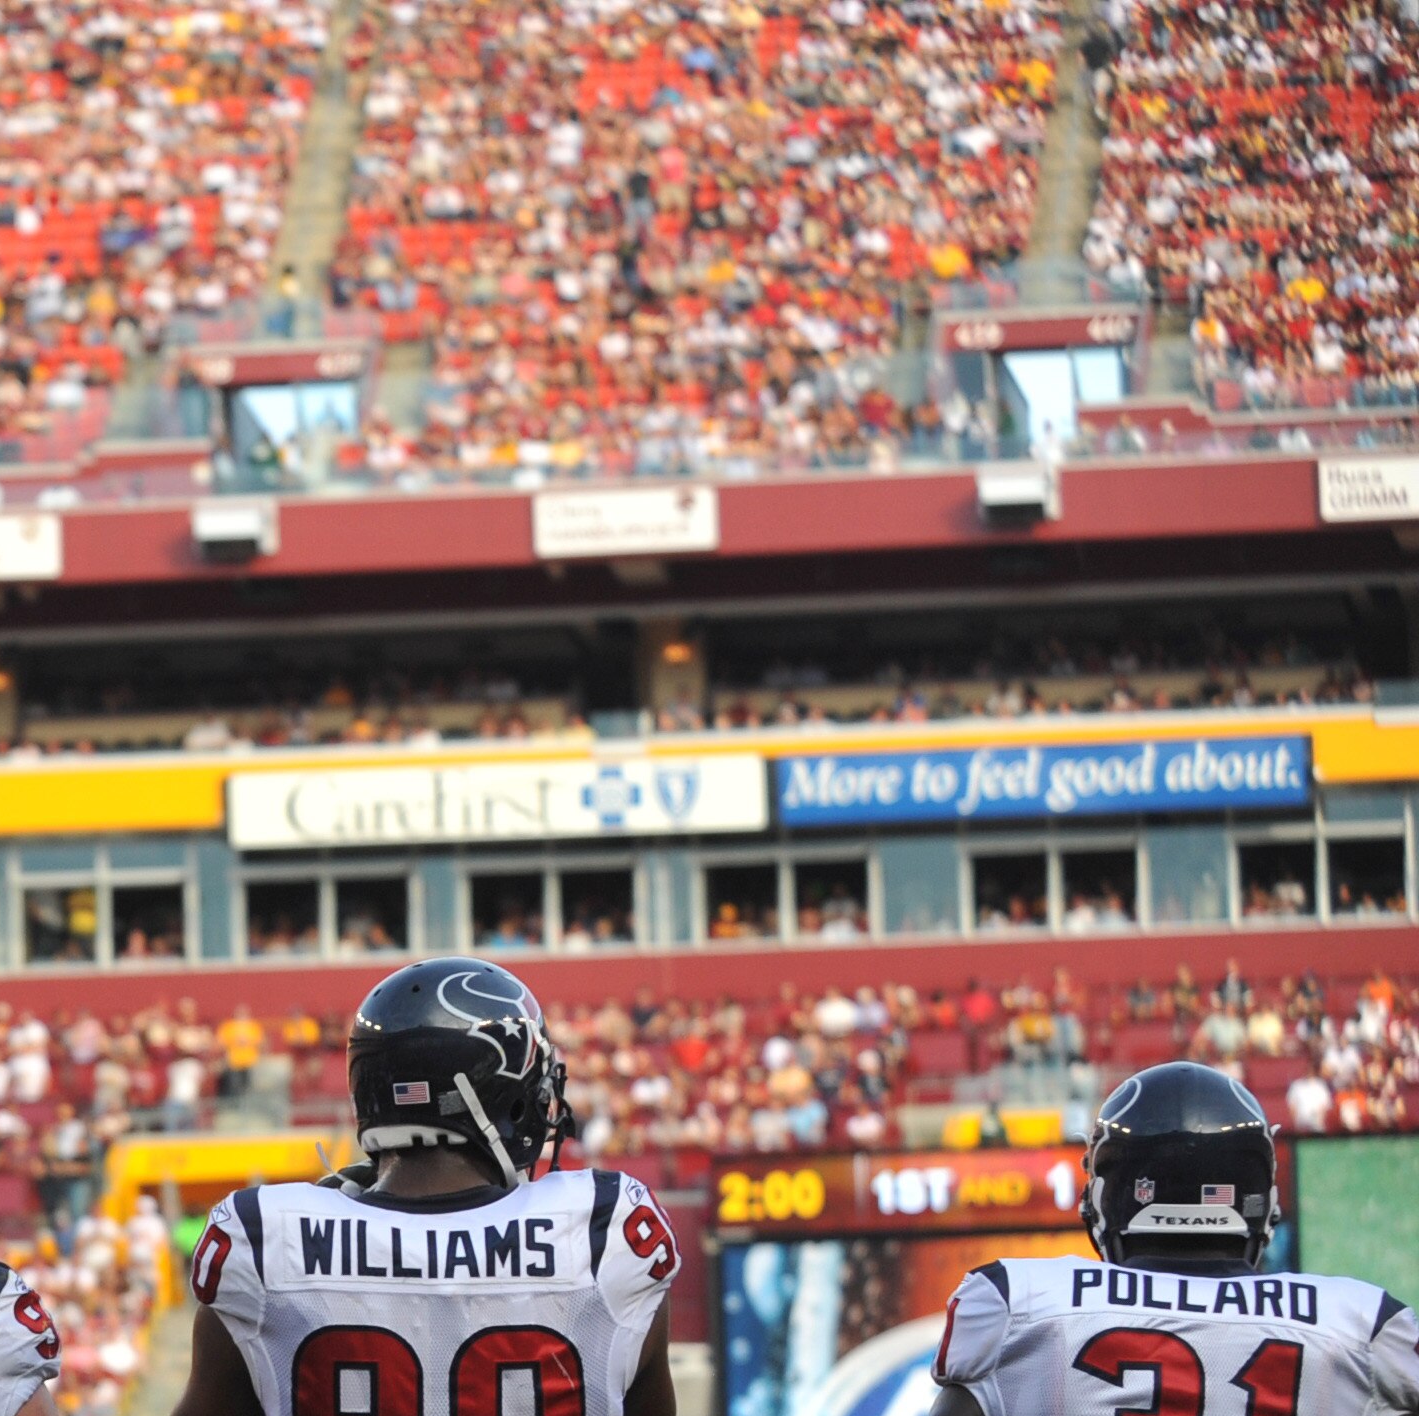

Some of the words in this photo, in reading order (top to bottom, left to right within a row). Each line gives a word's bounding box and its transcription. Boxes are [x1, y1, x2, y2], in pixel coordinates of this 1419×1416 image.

[782, 757, 901, 808] More
[911, 757, 958, 802] to
[956, 746, 1042, 816] feel
[1044, 739, 1157, 813] good
[1165, 738, 1301, 792] about.
[717, 1169, 825, 1222] 2:00
[871, 1167, 954, 1214] 1ST
[299, 1217, 555, 1278] WILLIAMS
[622, 1192, 676, 1281] 9
[1151, 1215, 1229, 1226] TEXANS
[1071, 1267, 1319, 1326] POLLARD
